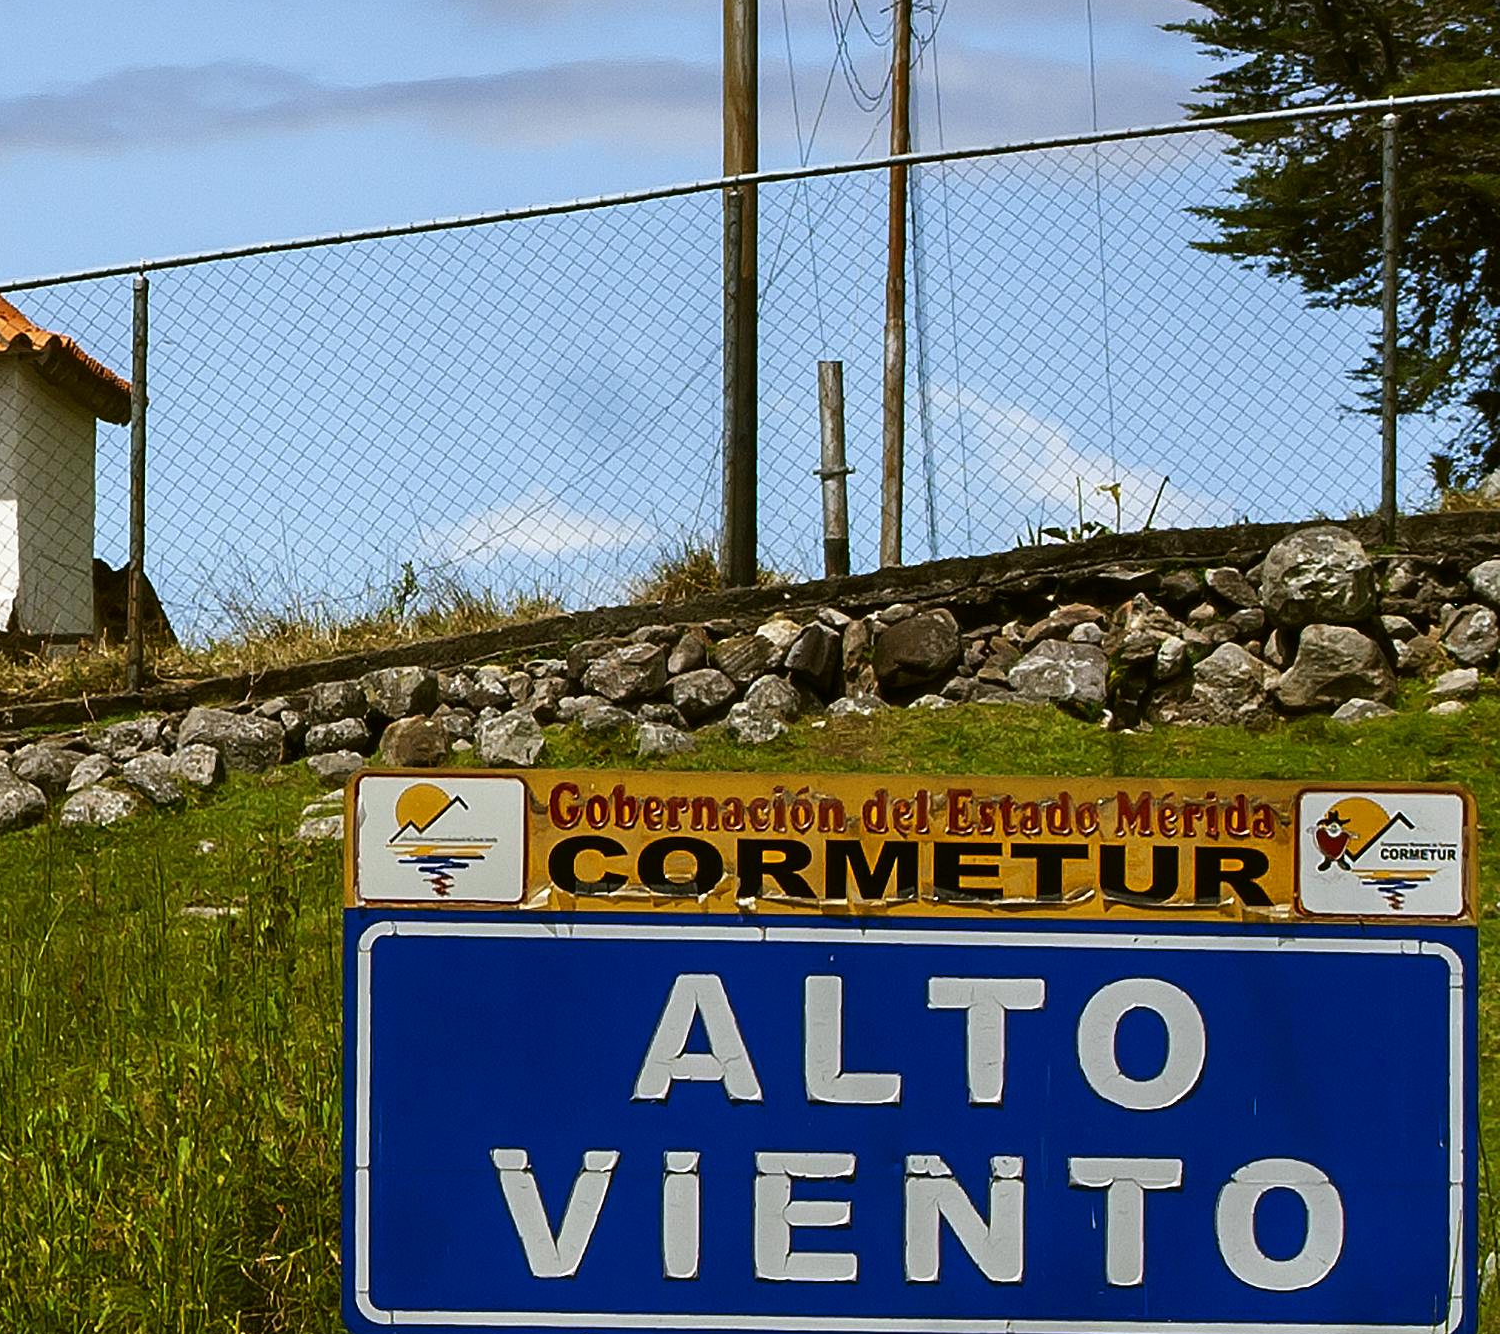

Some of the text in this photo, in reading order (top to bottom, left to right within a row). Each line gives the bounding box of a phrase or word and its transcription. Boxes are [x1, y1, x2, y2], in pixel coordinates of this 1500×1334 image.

[550, 782, 1275, 840] Gobernación del Estado Mérida
[548, 835, 1274, 907] CORMETUR
[1380, 848, 1456, 860] CORMETUR
[630, 973, 1206, 1111] ALTO
[490, 1149, 1344, 1291] VIENTO
